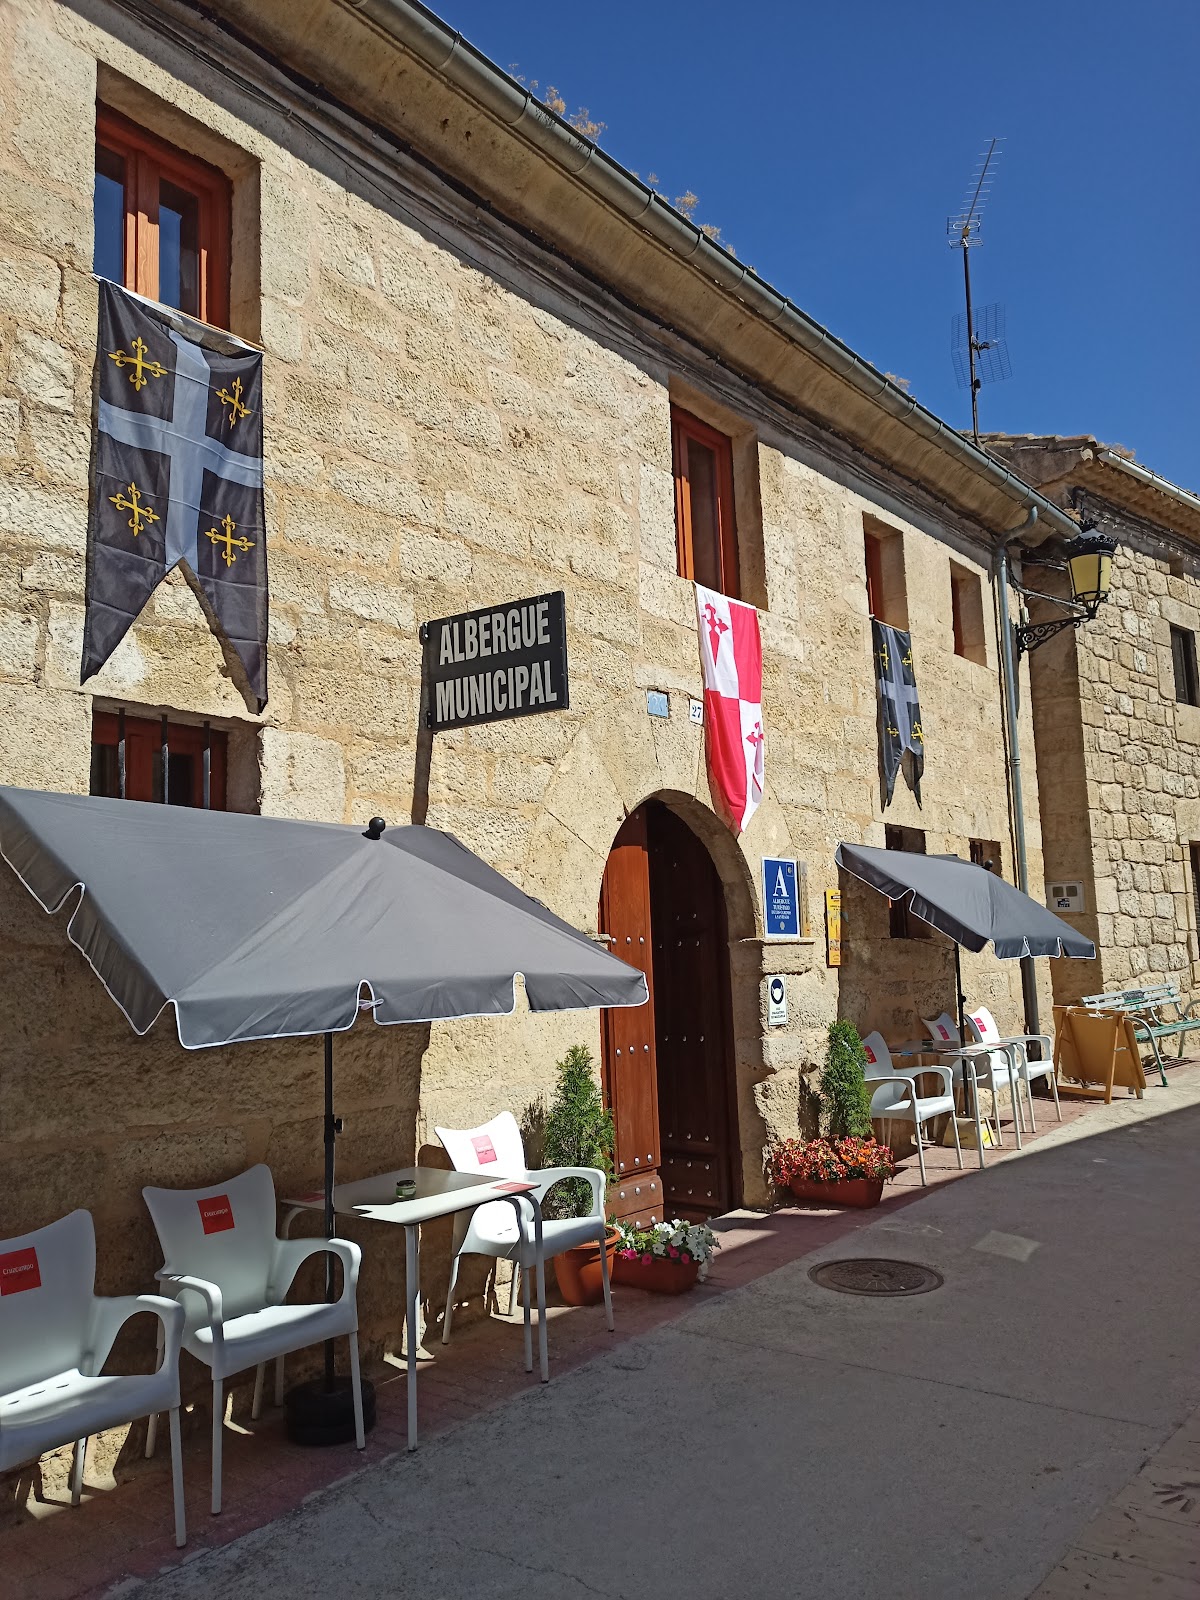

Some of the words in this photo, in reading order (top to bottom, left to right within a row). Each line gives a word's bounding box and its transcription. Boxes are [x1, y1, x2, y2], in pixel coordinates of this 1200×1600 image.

[440, 602, 550, 665] ALBERGUE
[436, 660, 557, 722] MUNICIPAL
[692, 705, 702, 718] 27
[773, 866, 790, 897] A
